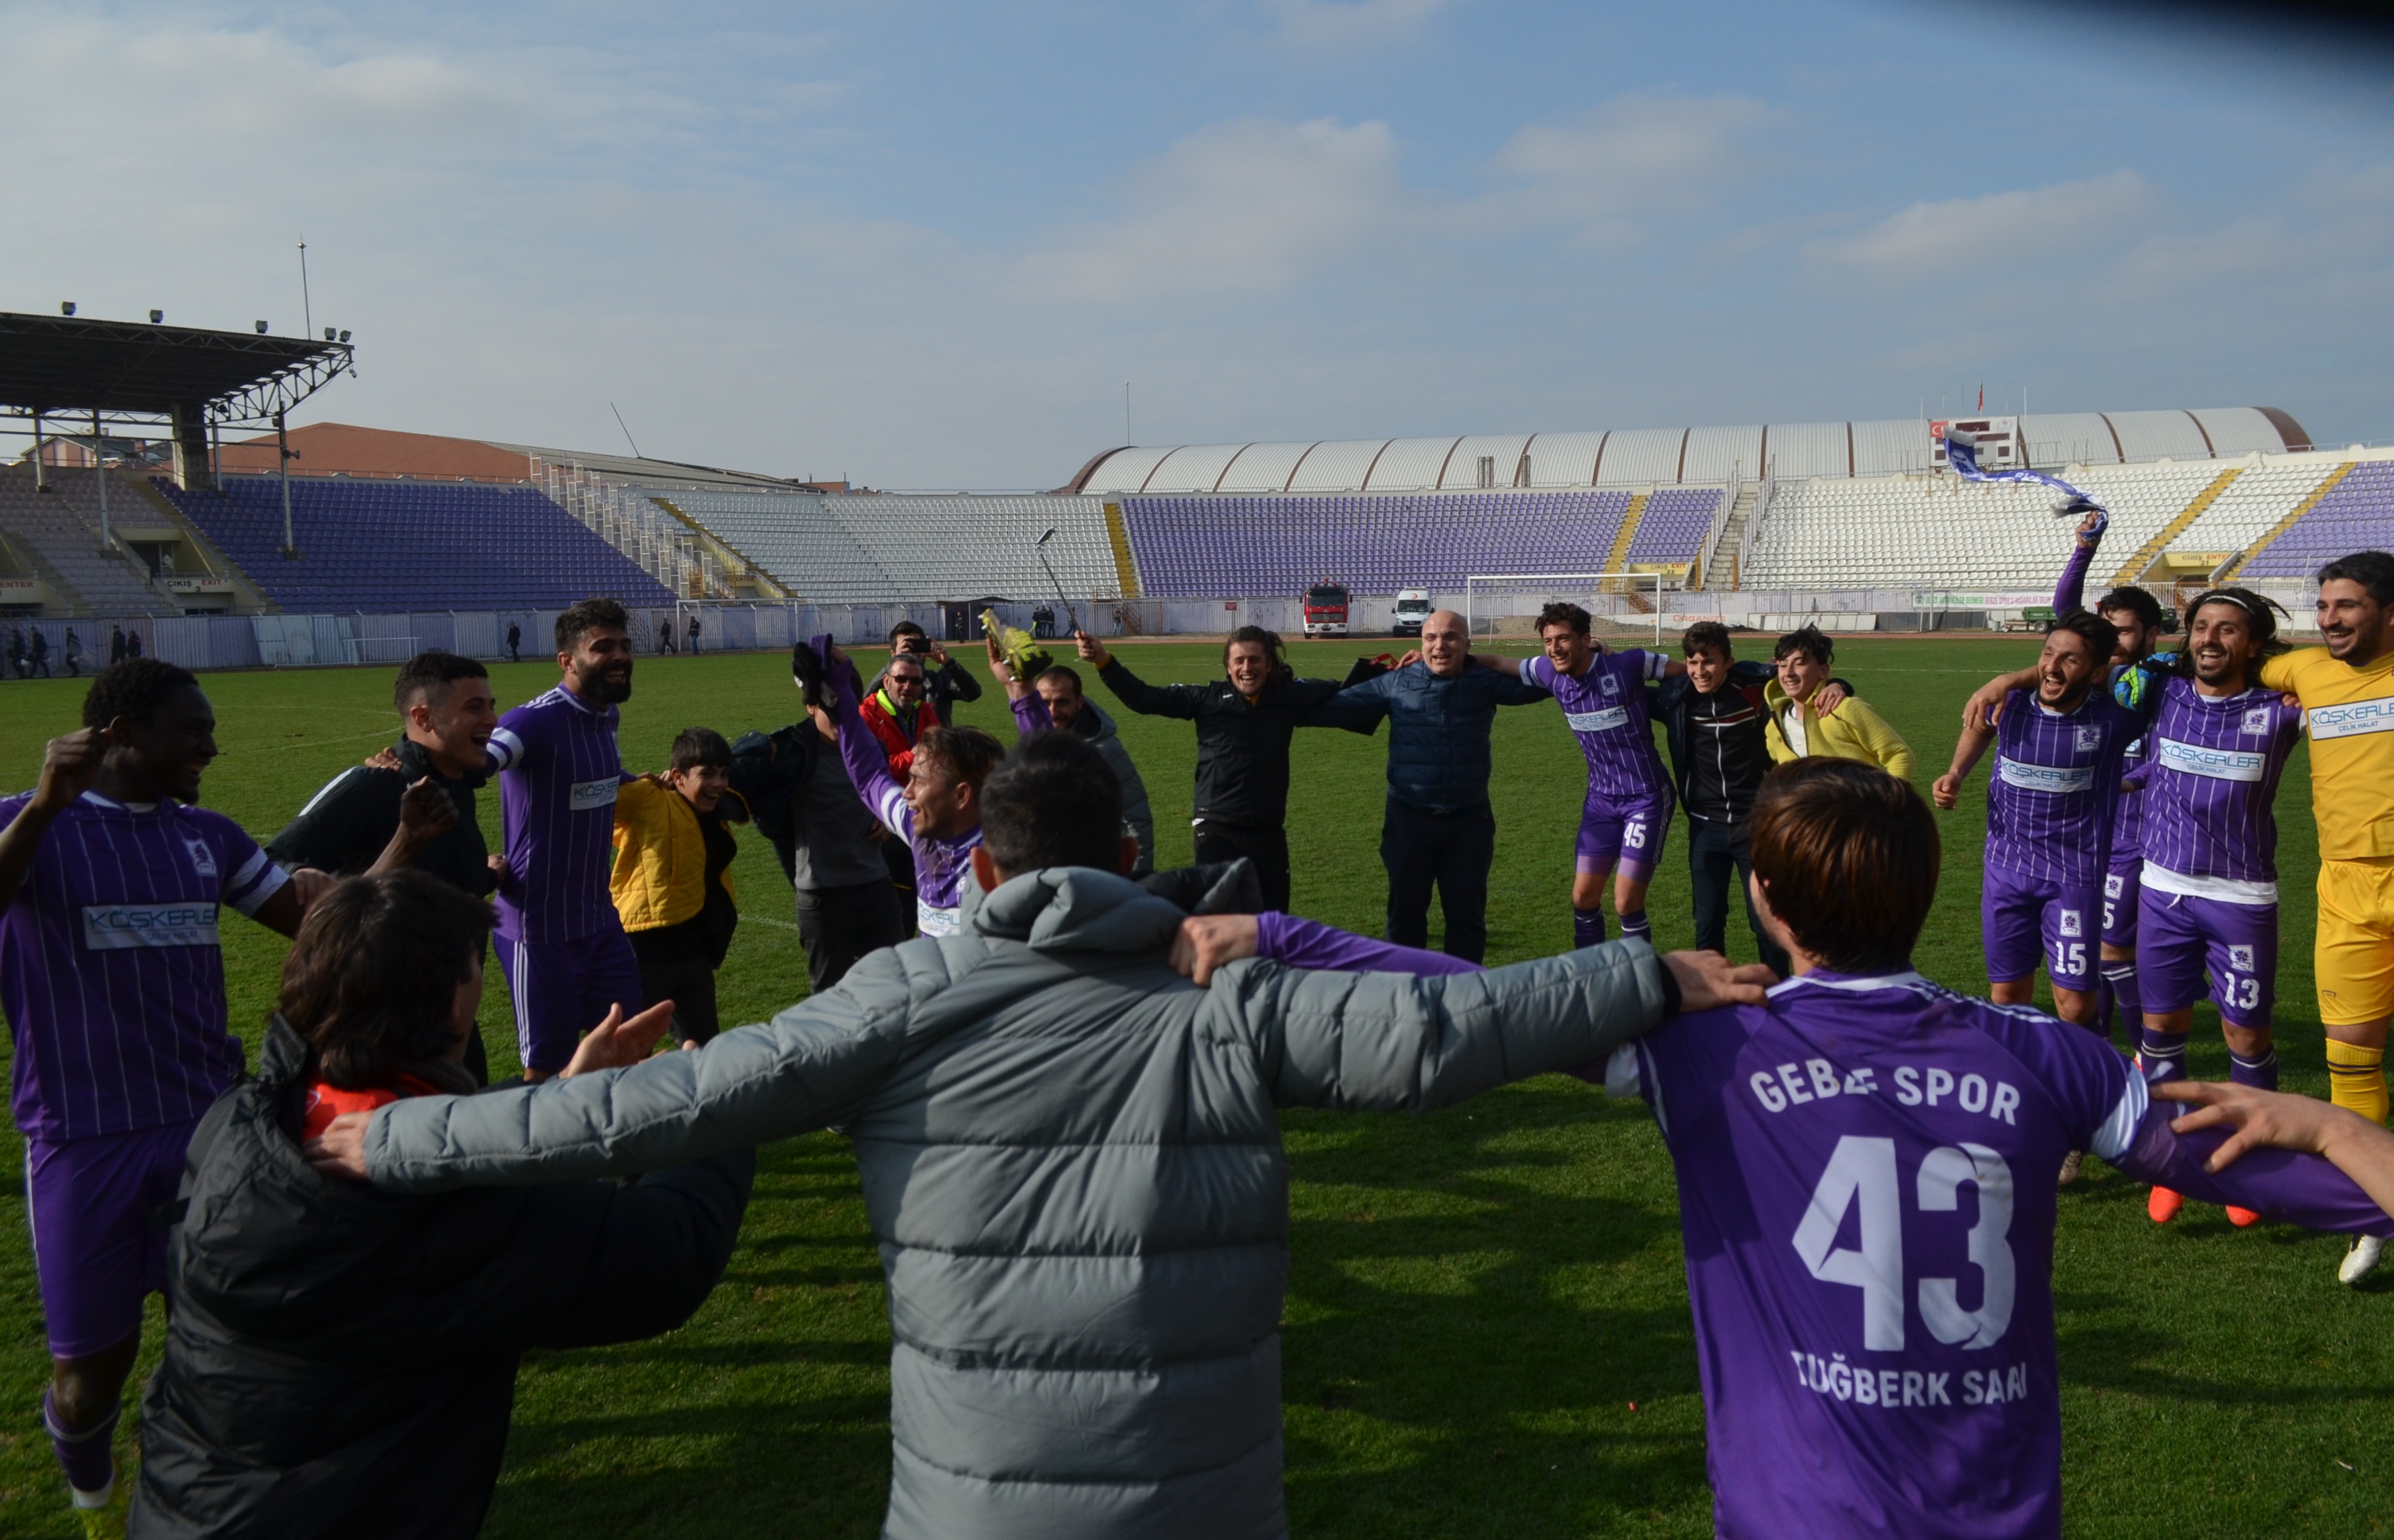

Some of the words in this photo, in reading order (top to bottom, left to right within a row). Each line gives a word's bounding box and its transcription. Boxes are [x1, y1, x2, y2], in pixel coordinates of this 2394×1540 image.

[2338, 724, 2357, 732] ÇELİK
[2003, 760, 2090, 781] KÖŞKERLER
[2162, 742, 2260, 769] KÖŞKERLER
[1624, 822, 1646, 849] 45
[2055, 940, 2087, 976] 15
[2224, 971, 2260, 1010] 13
[1893, 1066, 2020, 1126] SPOR
[1792, 1135, 2016, 1351] 43
[1791, 1351, 1951, 1408] TUĞBERK
